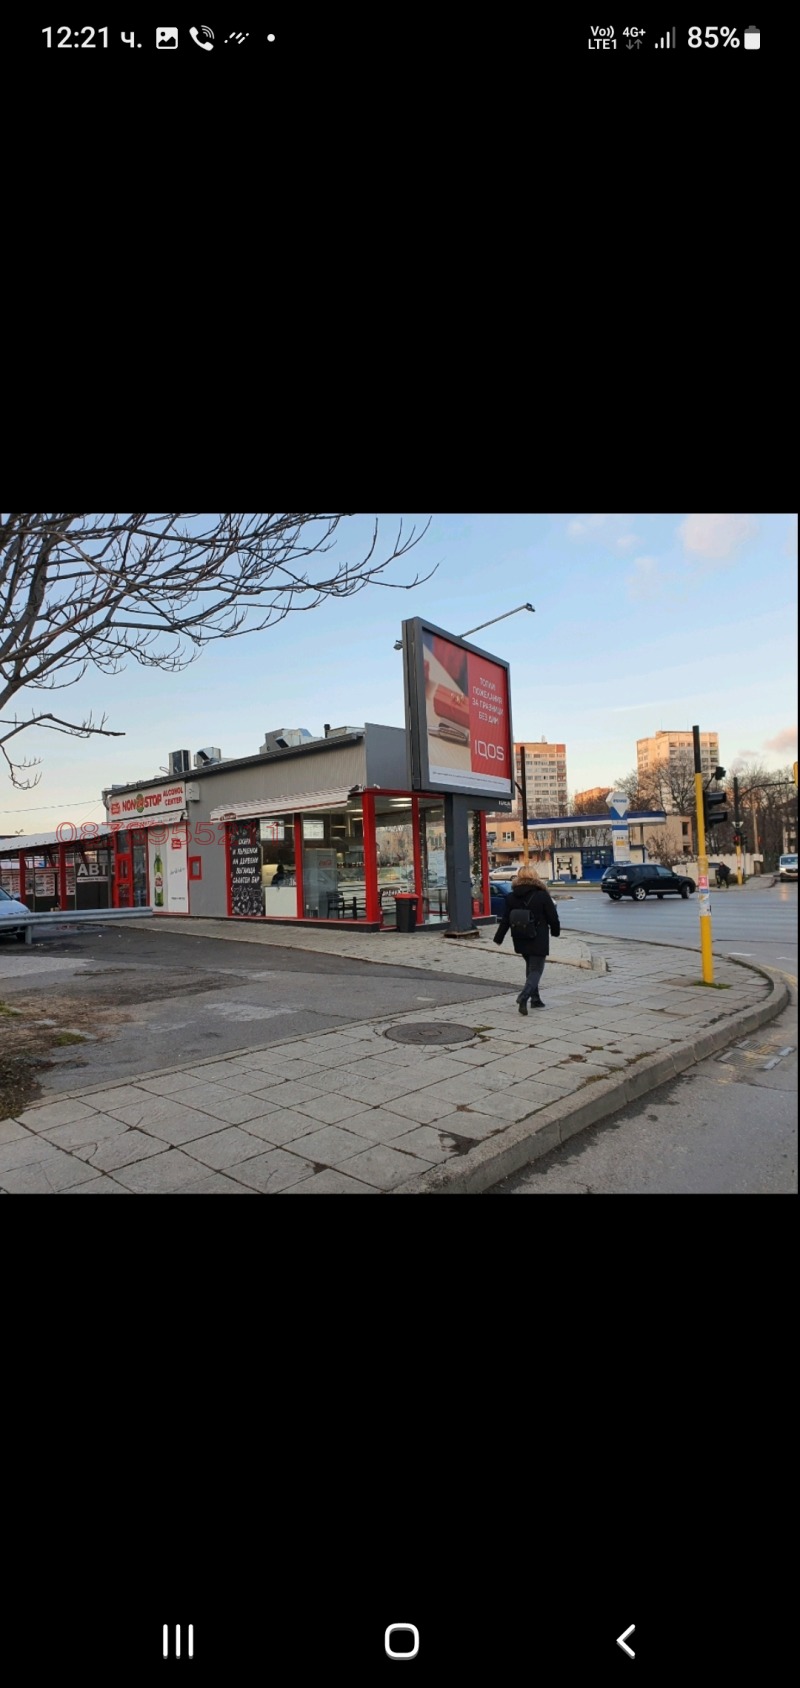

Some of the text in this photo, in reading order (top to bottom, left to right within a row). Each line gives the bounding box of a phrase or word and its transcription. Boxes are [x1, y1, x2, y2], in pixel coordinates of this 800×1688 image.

[42, 26, 142, 48] 12:21 ч.
[623, 27, 646, 37] 4G+
[688, 26, 740, 48] 85%
[589, 39, 616, 49] LTE1
[472, 698, 479, 706] ЗА
[473, 686, 503, 704] ПОЖЕЛАНИЯ
[474, 739, 504, 761] IQOS
[163, 786, 184, 797] ALCOHOL
[122, 798, 136, 812] NON
[143, 793, 162, 808] STOP
[165, 796, 183, 806] CENTER
